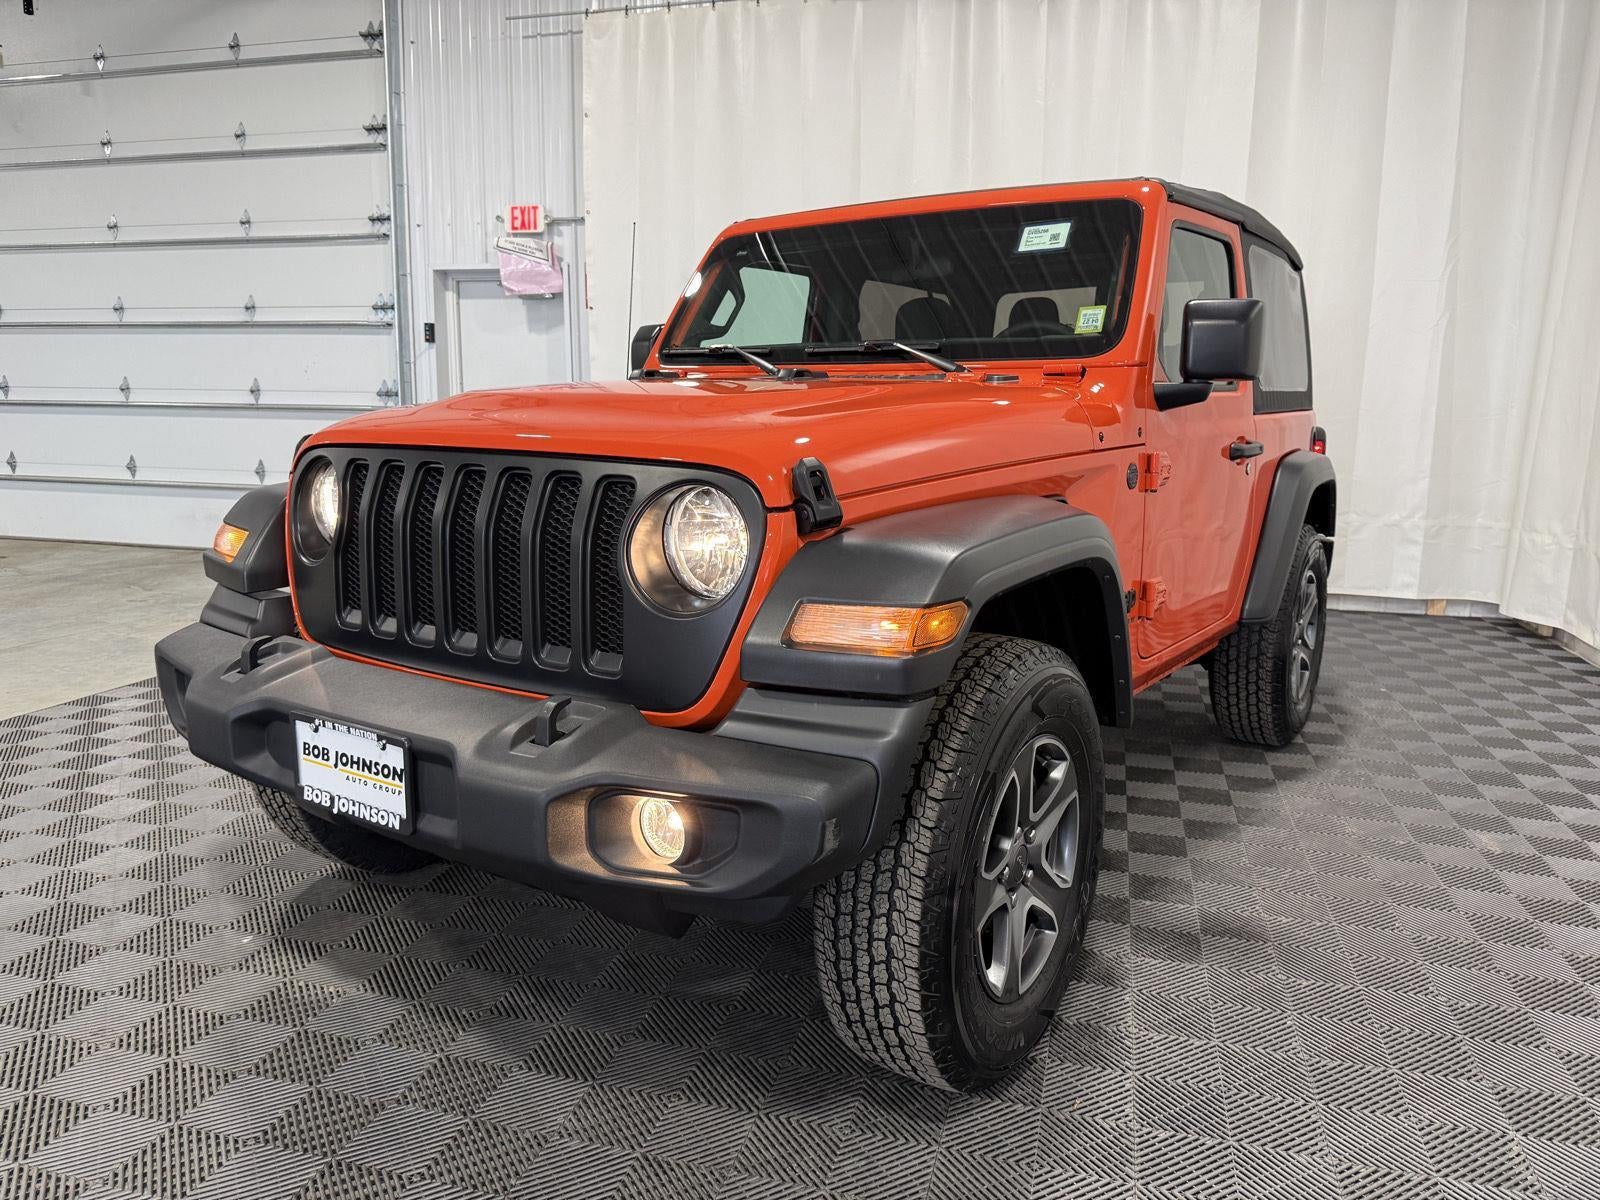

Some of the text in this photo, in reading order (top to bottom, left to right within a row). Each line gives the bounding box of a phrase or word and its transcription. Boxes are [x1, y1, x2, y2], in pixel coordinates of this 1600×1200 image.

[511, 206, 538, 230] EXIT
[325, 721, 333, 730] IN
[335, 723, 348, 734] THE
[350, 727, 378, 741] NATION
[303, 742, 404, 783] BOB JOHNSON
[345, 776, 402, 795] AUTO GROUP
[303, 785, 400, 830] BOB JOHNSON
